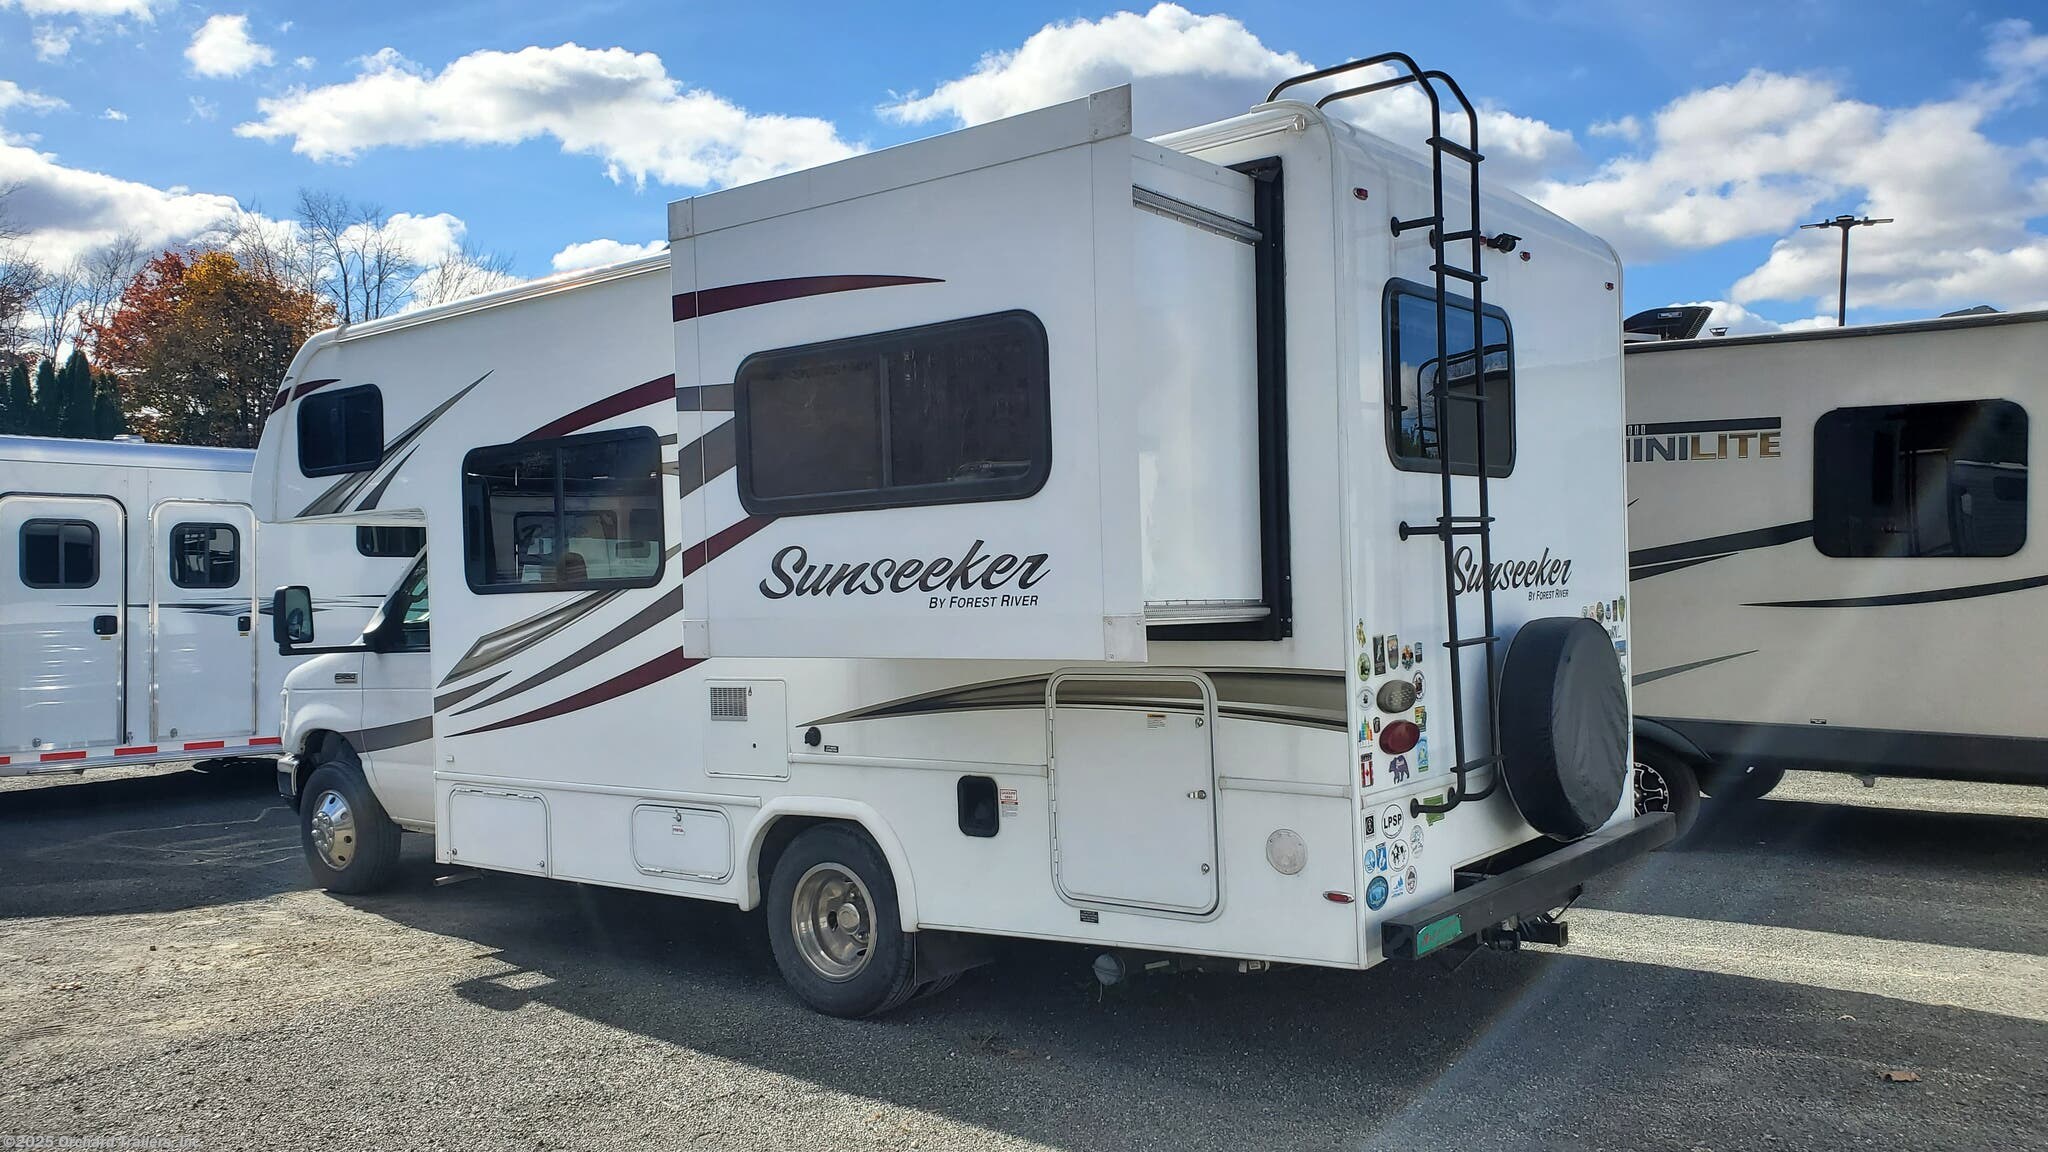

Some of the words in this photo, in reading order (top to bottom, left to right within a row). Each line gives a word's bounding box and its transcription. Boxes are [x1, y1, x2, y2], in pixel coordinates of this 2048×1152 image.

[1626, 431, 1781, 462] INILITE
[759, 539, 1051, 600] Sunseeker
[949, 595, 997, 608] FOREST
[1000, 594, 1039, 607] RIVER
[1383, 813, 1402, 829] LPSP
